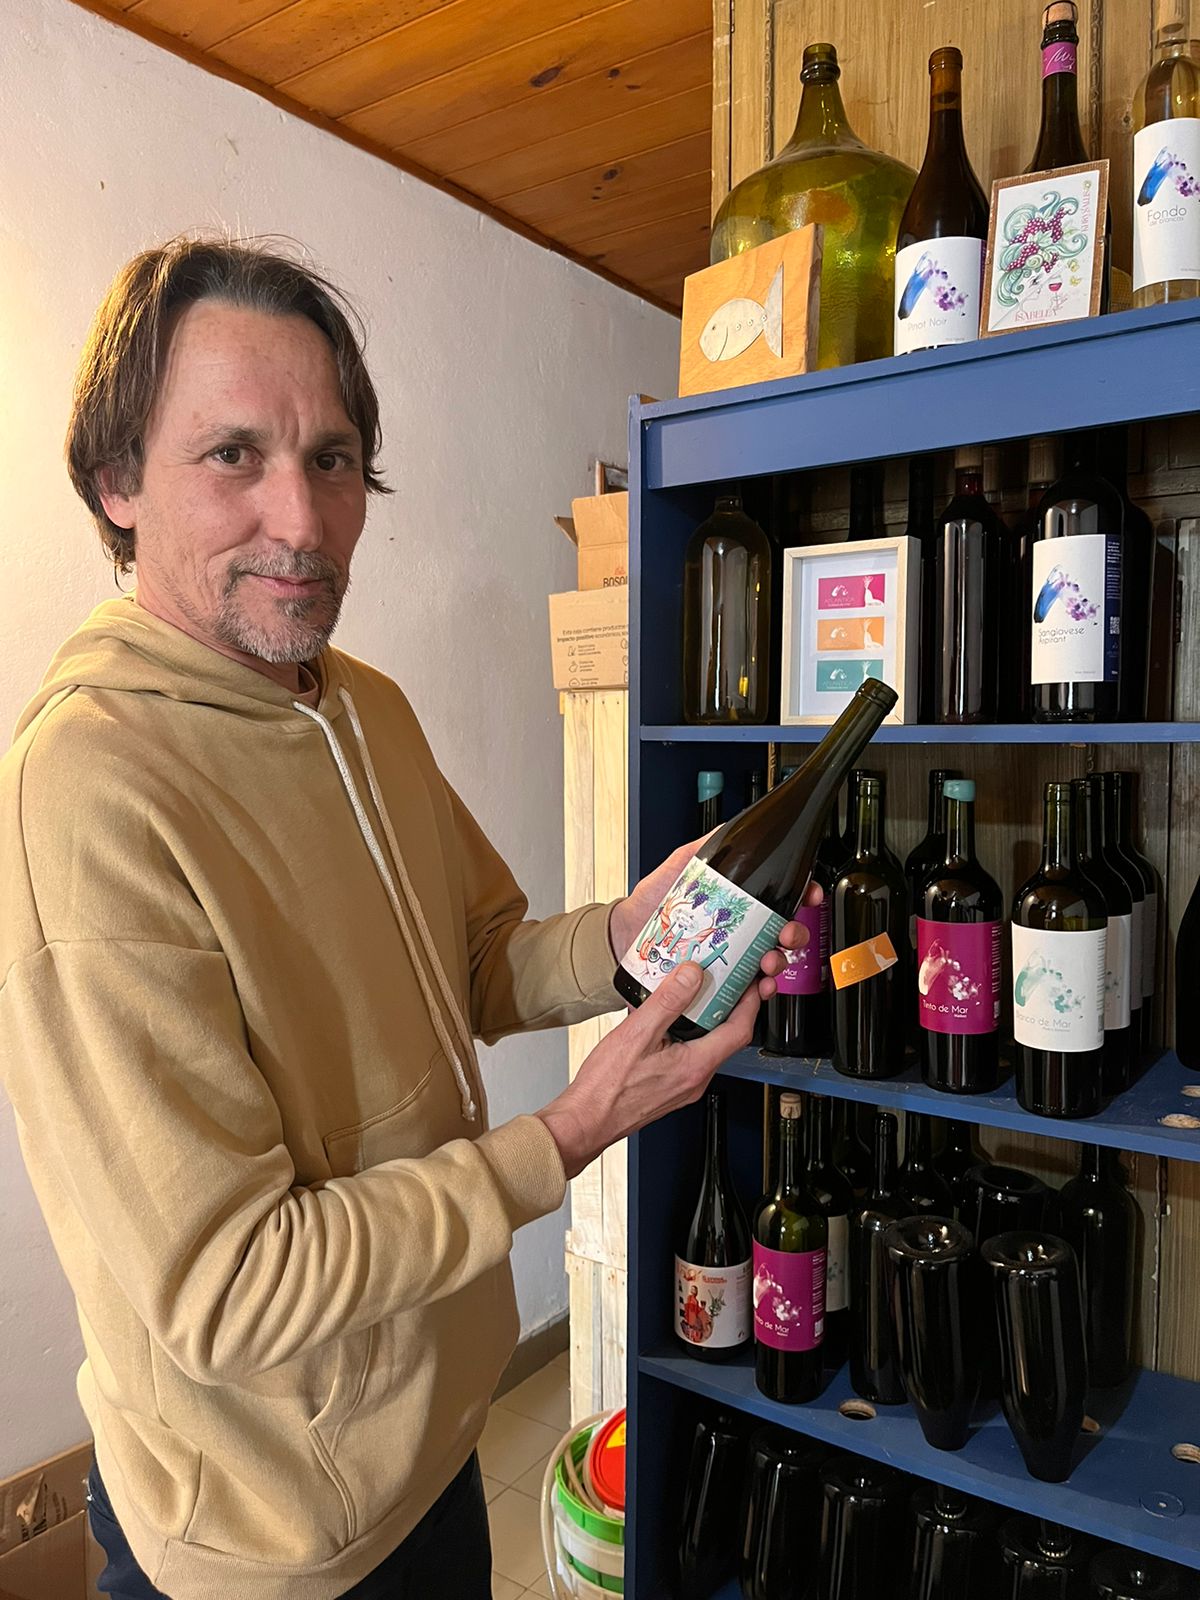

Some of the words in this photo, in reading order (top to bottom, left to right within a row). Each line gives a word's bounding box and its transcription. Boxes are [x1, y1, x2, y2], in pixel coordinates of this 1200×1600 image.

[1147, 204, 1187, 222] Fondo
[929, 317, 947, 328] Noir
[782, 968, 798, 977] Mar
[922, 999, 937, 1011] Tinto
[938, 1004, 949, 1013] de
[951, 1005, 969, 1014] Mar
[1038, 1015, 1050, 1026] de
[1053, 1018, 1072, 1028] Mar
[764, 1320, 774, 1330] de
[775, 1323, 790, 1333] Mar
